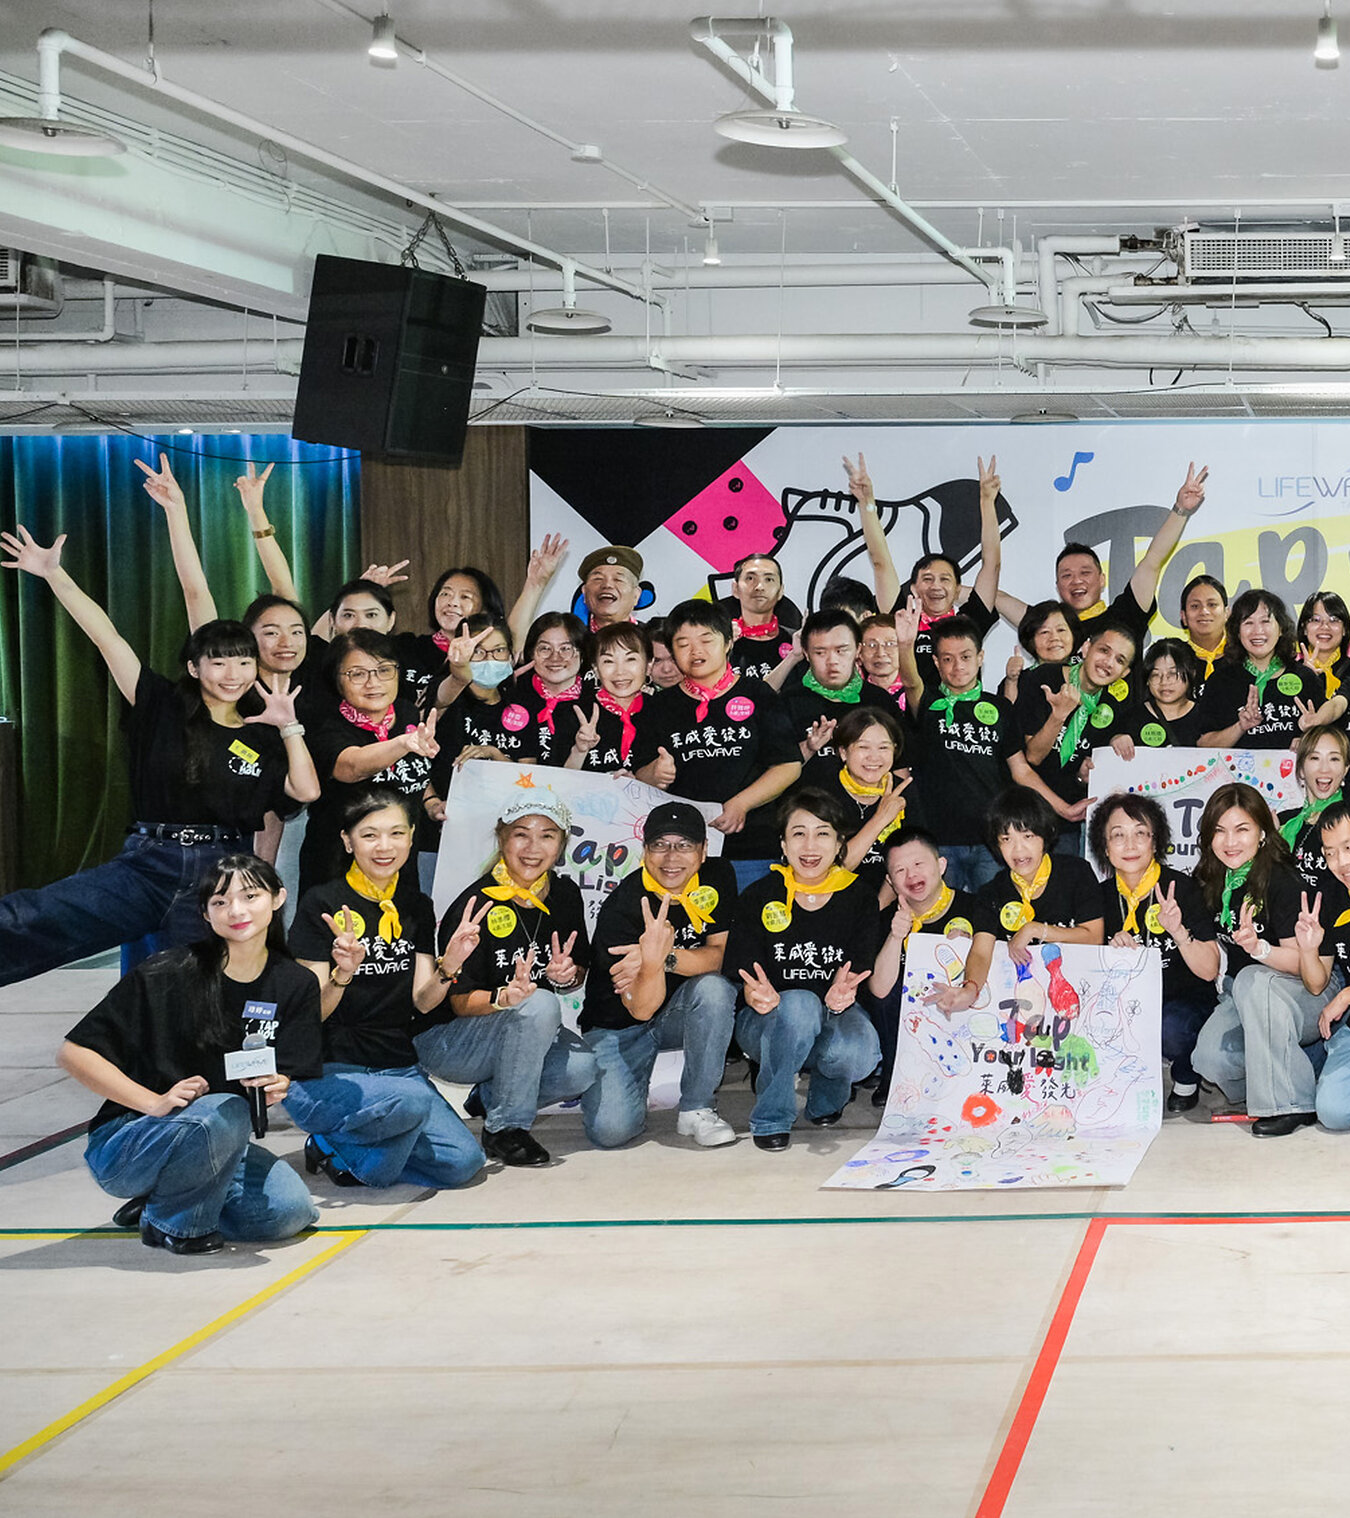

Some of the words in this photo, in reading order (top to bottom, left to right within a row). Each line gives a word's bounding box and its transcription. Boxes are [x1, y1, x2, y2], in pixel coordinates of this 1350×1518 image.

[681, 746, 743, 762] LIFEWAVE
[944, 739, 993, 757] LIFEWAVE
[579, 870, 619, 894] Lig
[258, 1020, 280, 1031] TAP
